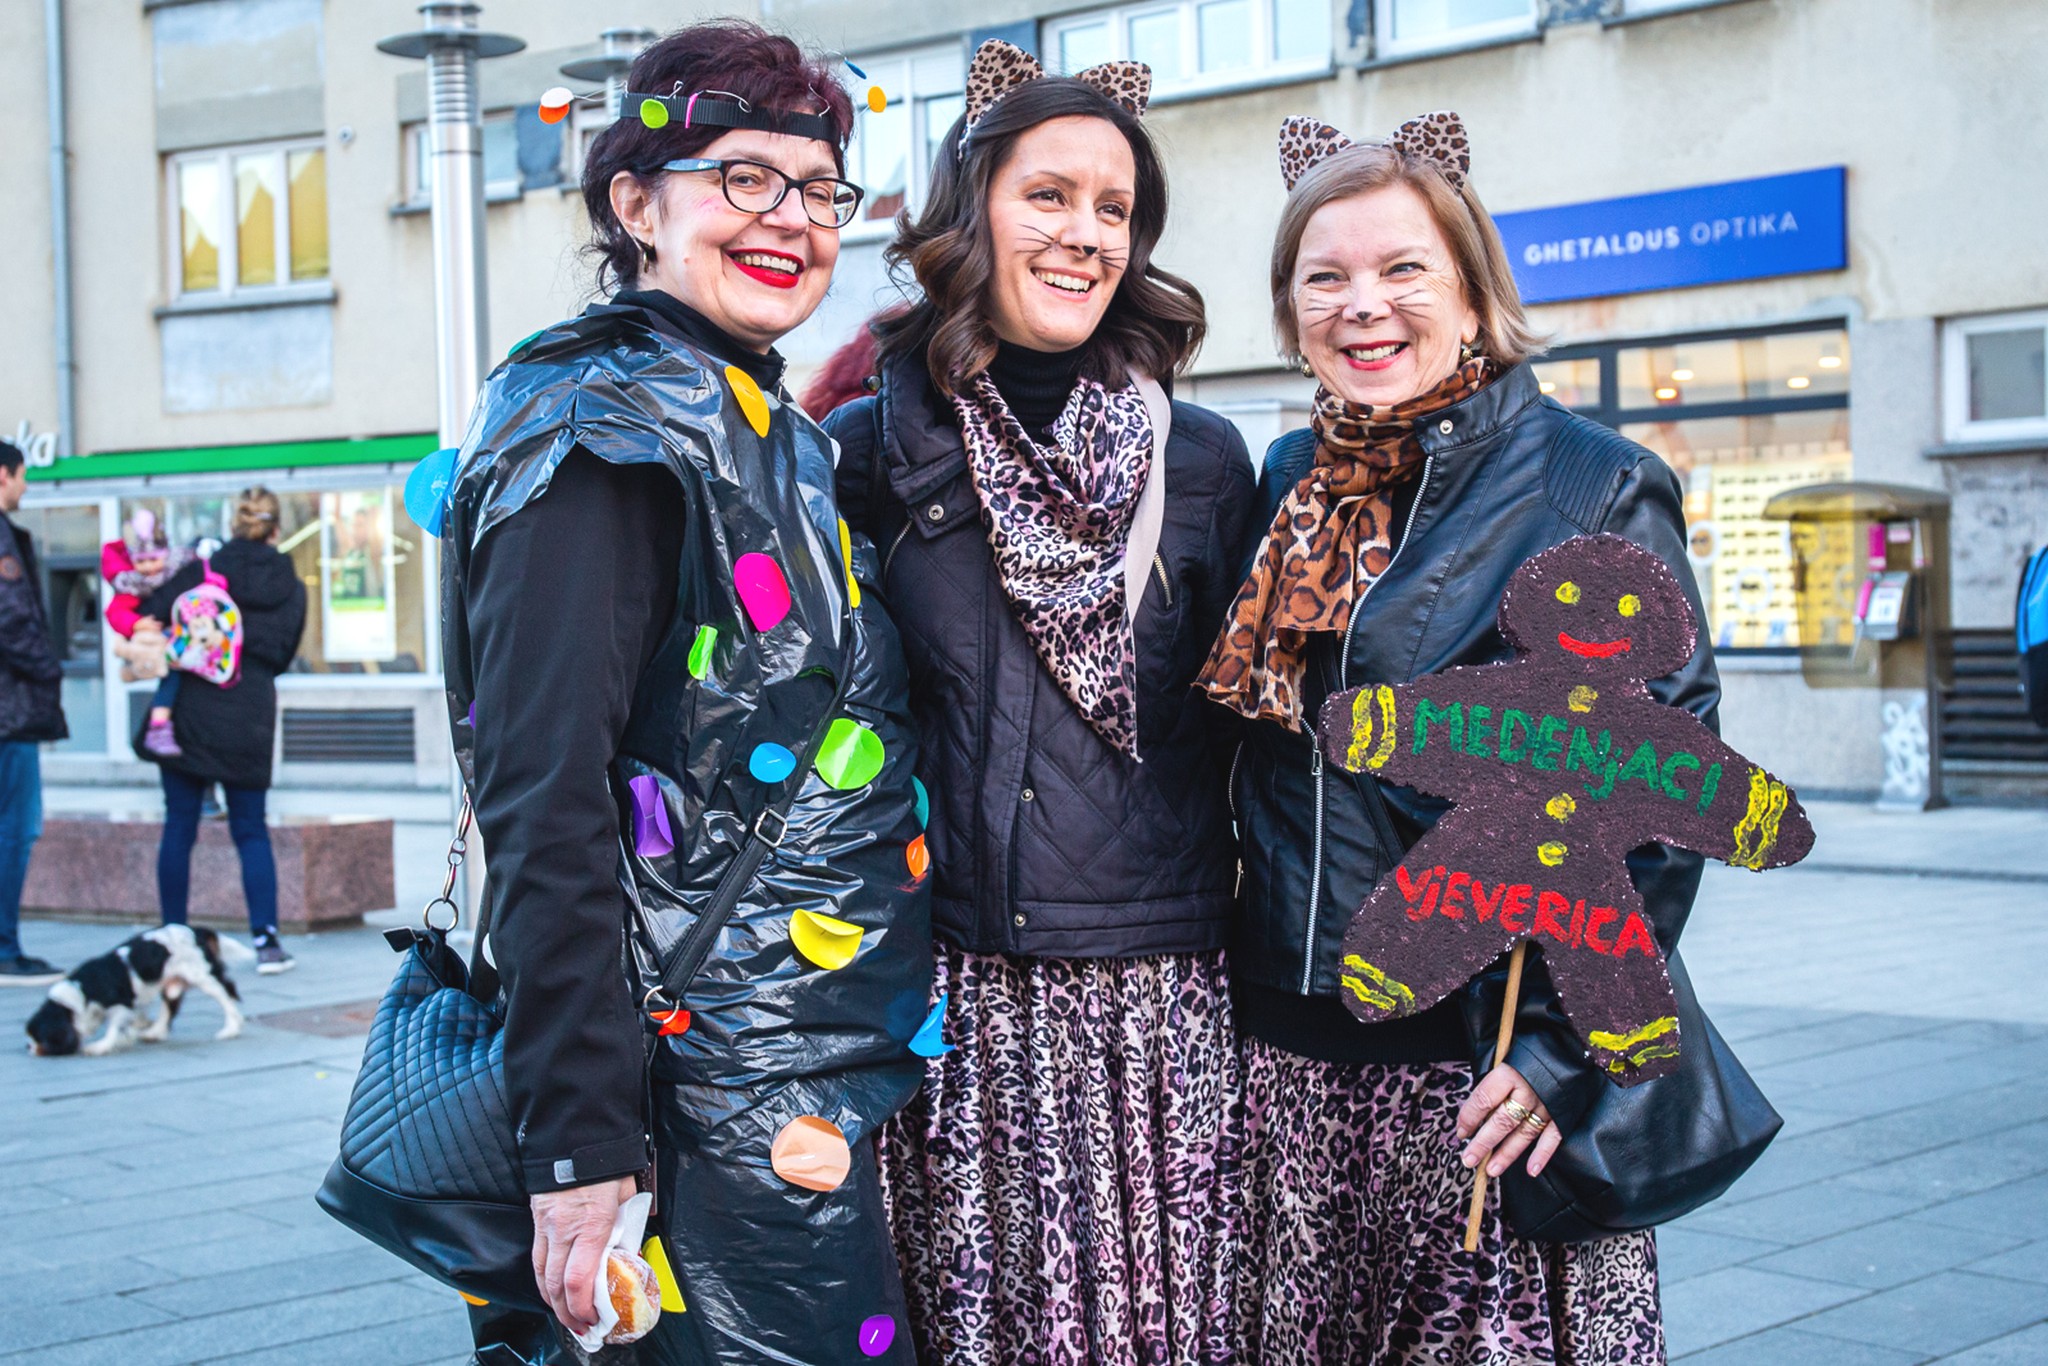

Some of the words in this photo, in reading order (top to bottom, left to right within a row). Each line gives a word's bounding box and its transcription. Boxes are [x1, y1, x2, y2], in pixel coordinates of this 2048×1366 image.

[1523, 226, 1680, 266] GHETALDUS
[1689, 211, 1799, 246] OPTIKA
[2, 419, 56, 468] ka
